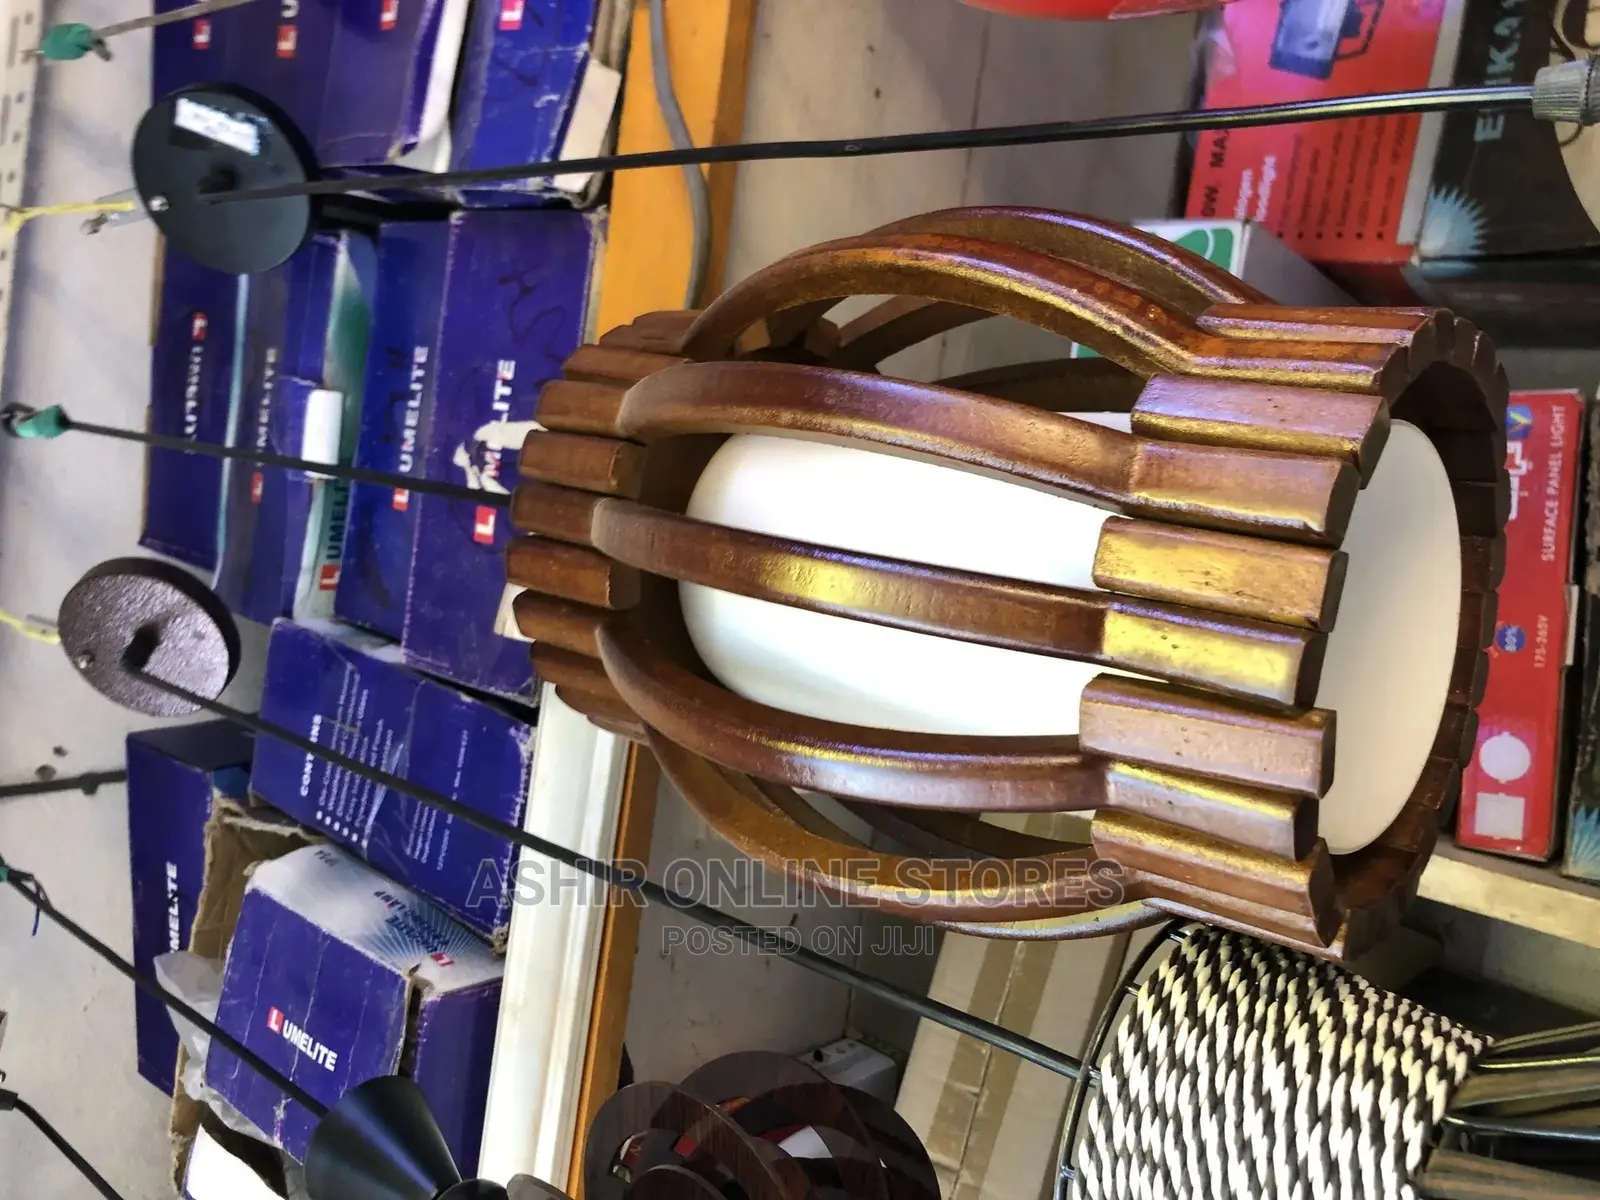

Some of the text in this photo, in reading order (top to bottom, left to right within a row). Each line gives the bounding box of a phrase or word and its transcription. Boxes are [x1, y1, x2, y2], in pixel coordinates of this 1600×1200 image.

[1541, 404, 1566, 562] SURFACE PANEL LIGHT
[301, 714, 322, 797] CONTINS
[266, 1006, 338, 1072] LUMELITE
